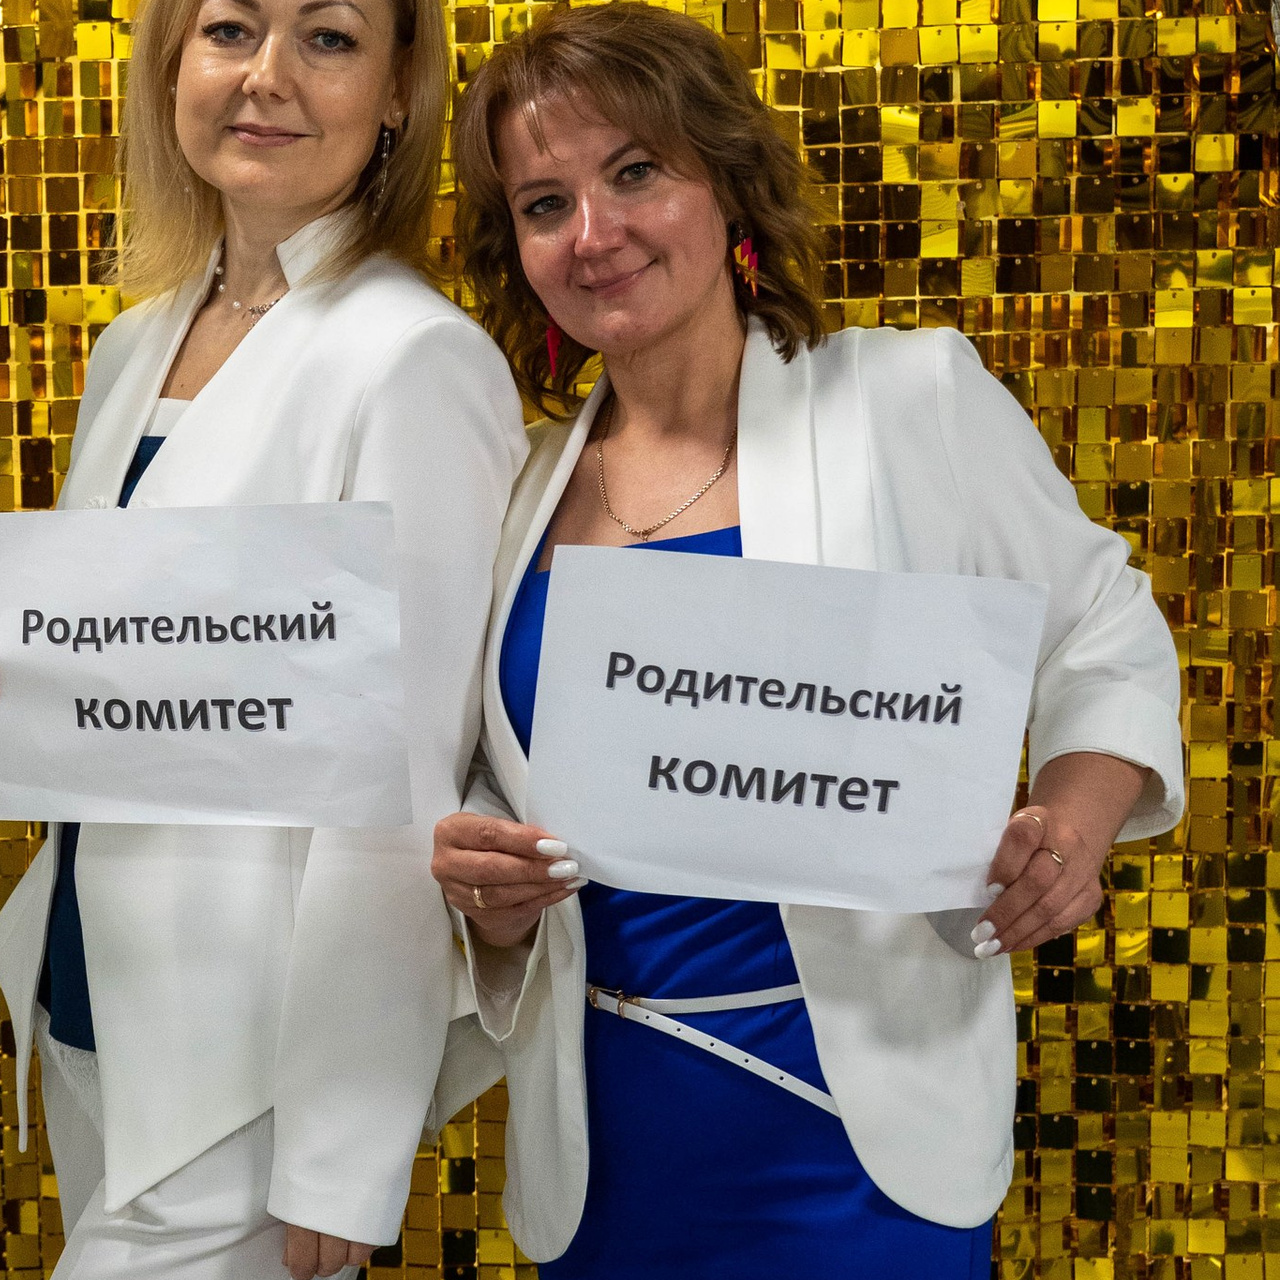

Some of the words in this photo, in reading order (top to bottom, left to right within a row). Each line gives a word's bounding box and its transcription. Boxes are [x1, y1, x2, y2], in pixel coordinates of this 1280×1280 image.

[22, 601, 336, 653] Родительский
[74, 696, 293, 731] комитет
[605, 651, 963, 725] Родительский
[648, 754, 901, 814] комитет
